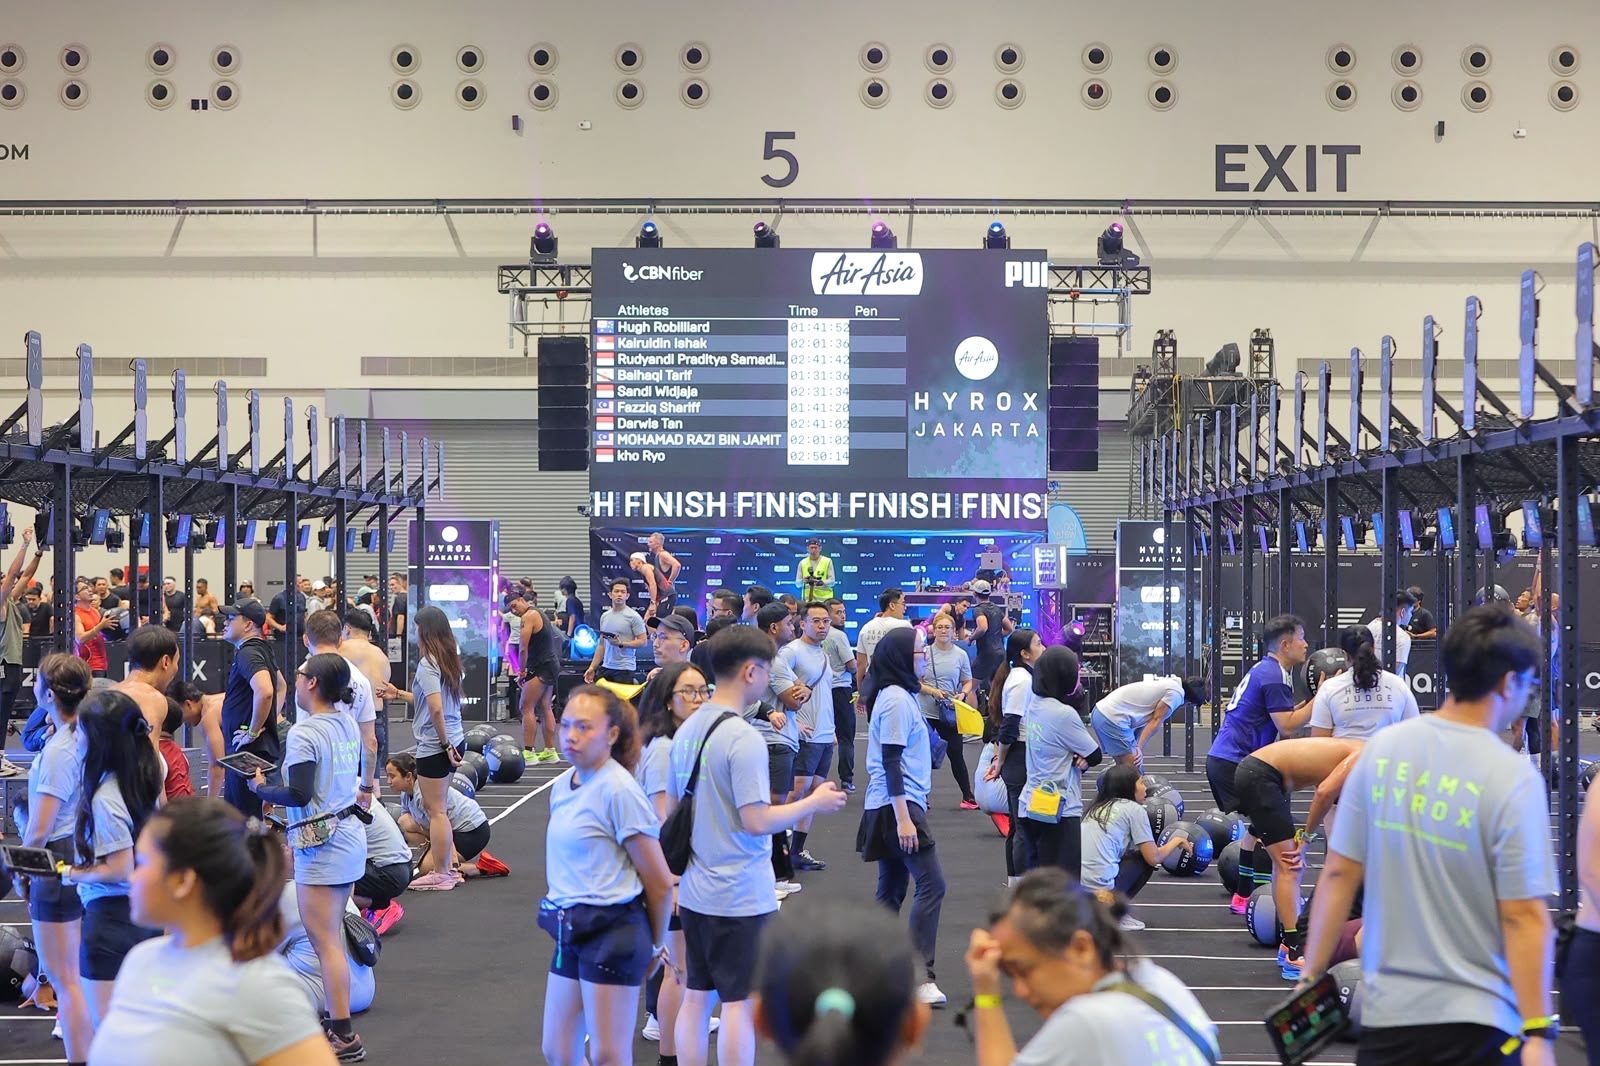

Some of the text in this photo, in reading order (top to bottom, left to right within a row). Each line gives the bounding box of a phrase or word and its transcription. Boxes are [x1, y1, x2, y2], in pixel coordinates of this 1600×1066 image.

[760, 131, 799, 188] 5
[1215, 144, 1361, 192] EXIT
[618, 305, 669, 316] Athletes
[788, 305, 818, 316] Time
[855, 306, 878, 316] Pen
[618, 321, 650, 335] Hugh
[675, 338, 708, 349] Ishak
[618, 353, 675, 366] Rudyandi
[678, 354, 728, 366] Praditya
[618, 370, 692, 383] Baihaqi Tarif
[618, 385, 698, 400] Sandi Widjaja
[914, 392, 1038, 411] HYROX
[618, 402, 700, 416] Fazziq Shariff
[618, 418, 683, 430] Darwis Tan
[915, 422, 1039, 437] JAKARTA
[618, 434, 782, 446] MOHAMAD RAZI BIN JAMIT
[617, 450, 666, 463] kho Ryo
[625, 491, 726, 518] FINISH
[737, 492, 839, 518] FINISH
[850, 492, 951, 519] FINISH
[1139, 546, 1182, 554] HYRX
[1344, 694, 1393, 704] JUDGE
[1375, 758, 1459, 797] TEAM
[1371, 784, 1475, 829] HYROX
[1160, 831, 1171, 847] CEN
[1231, 824, 1239, 841] CEN
